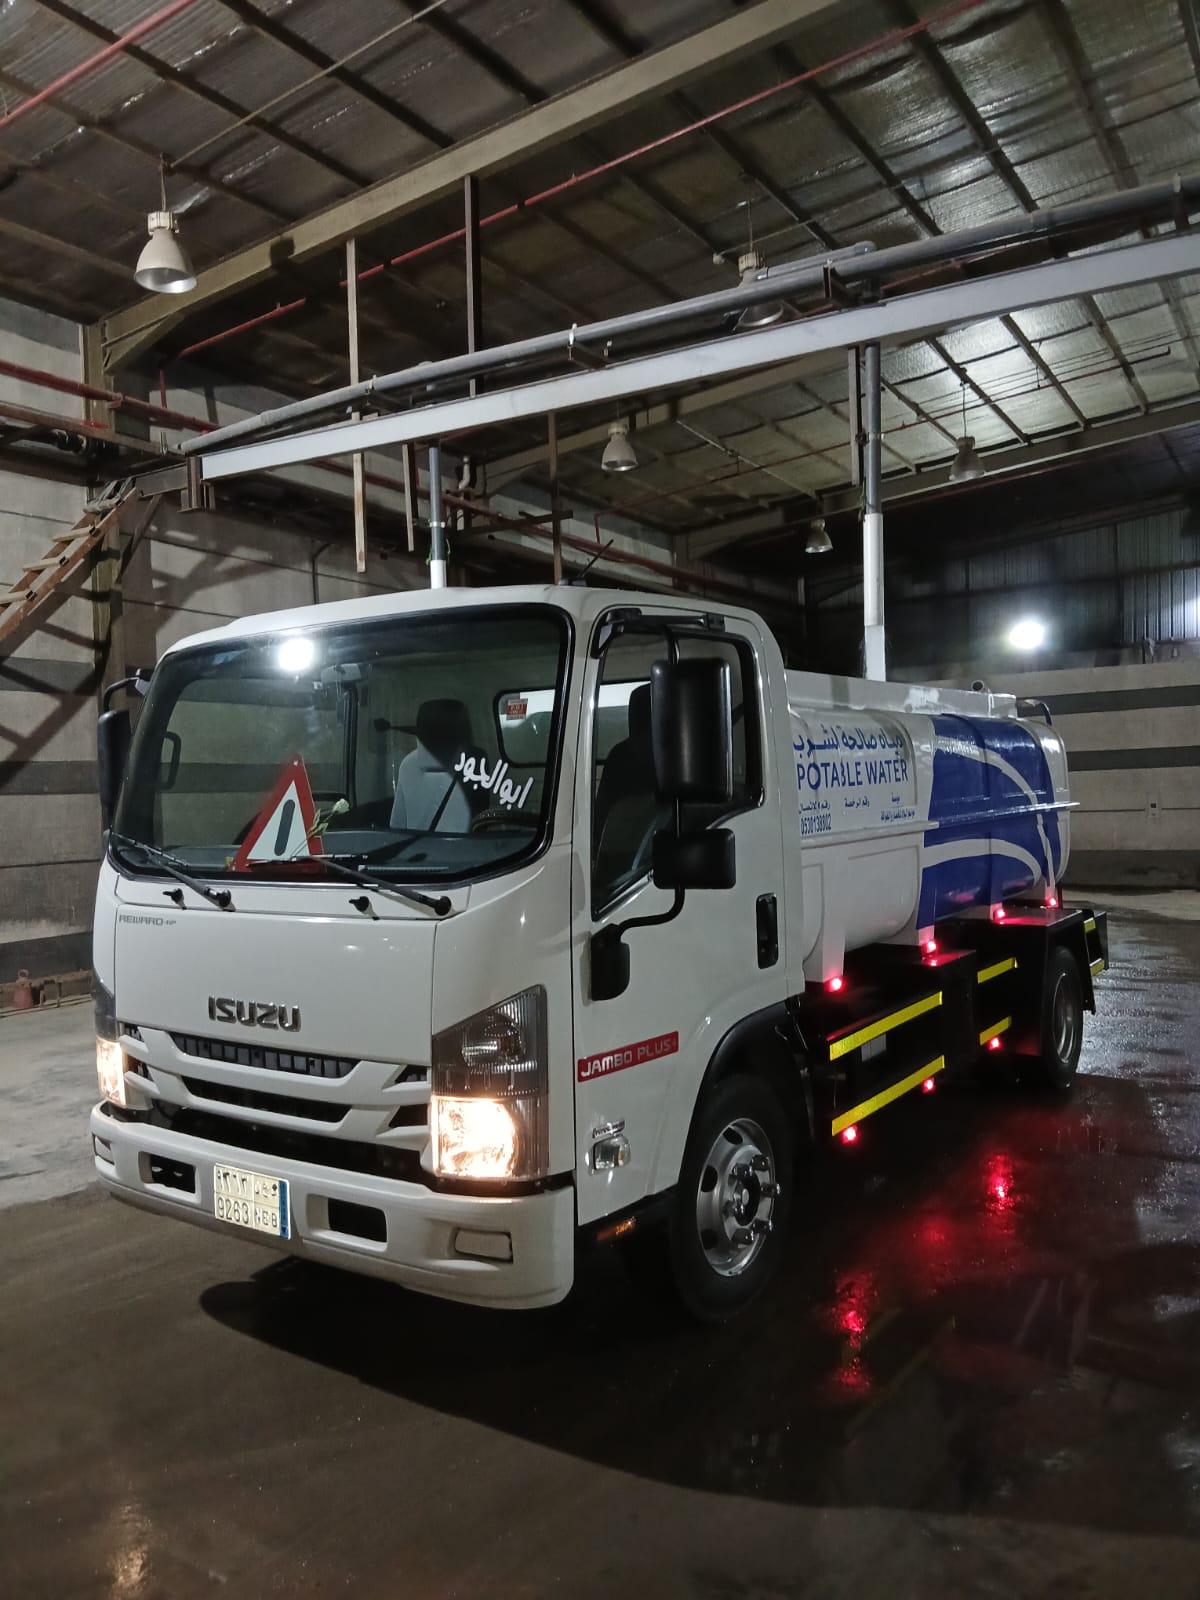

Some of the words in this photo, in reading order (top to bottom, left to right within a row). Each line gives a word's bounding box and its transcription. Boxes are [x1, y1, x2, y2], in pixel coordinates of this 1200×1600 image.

[836, 725, 878, 751] صالحة
[877, 727, 903, 756] مياه
[796, 761, 863, 791] POTABLE
[864, 758, 909, 785] WATER
[119, 914, 164, 926] REWARD
[207, 994, 302, 1033] ISUZU
[580, 1050, 633, 1077] JAMBO
[217, 1197, 249, 1225] 9263
